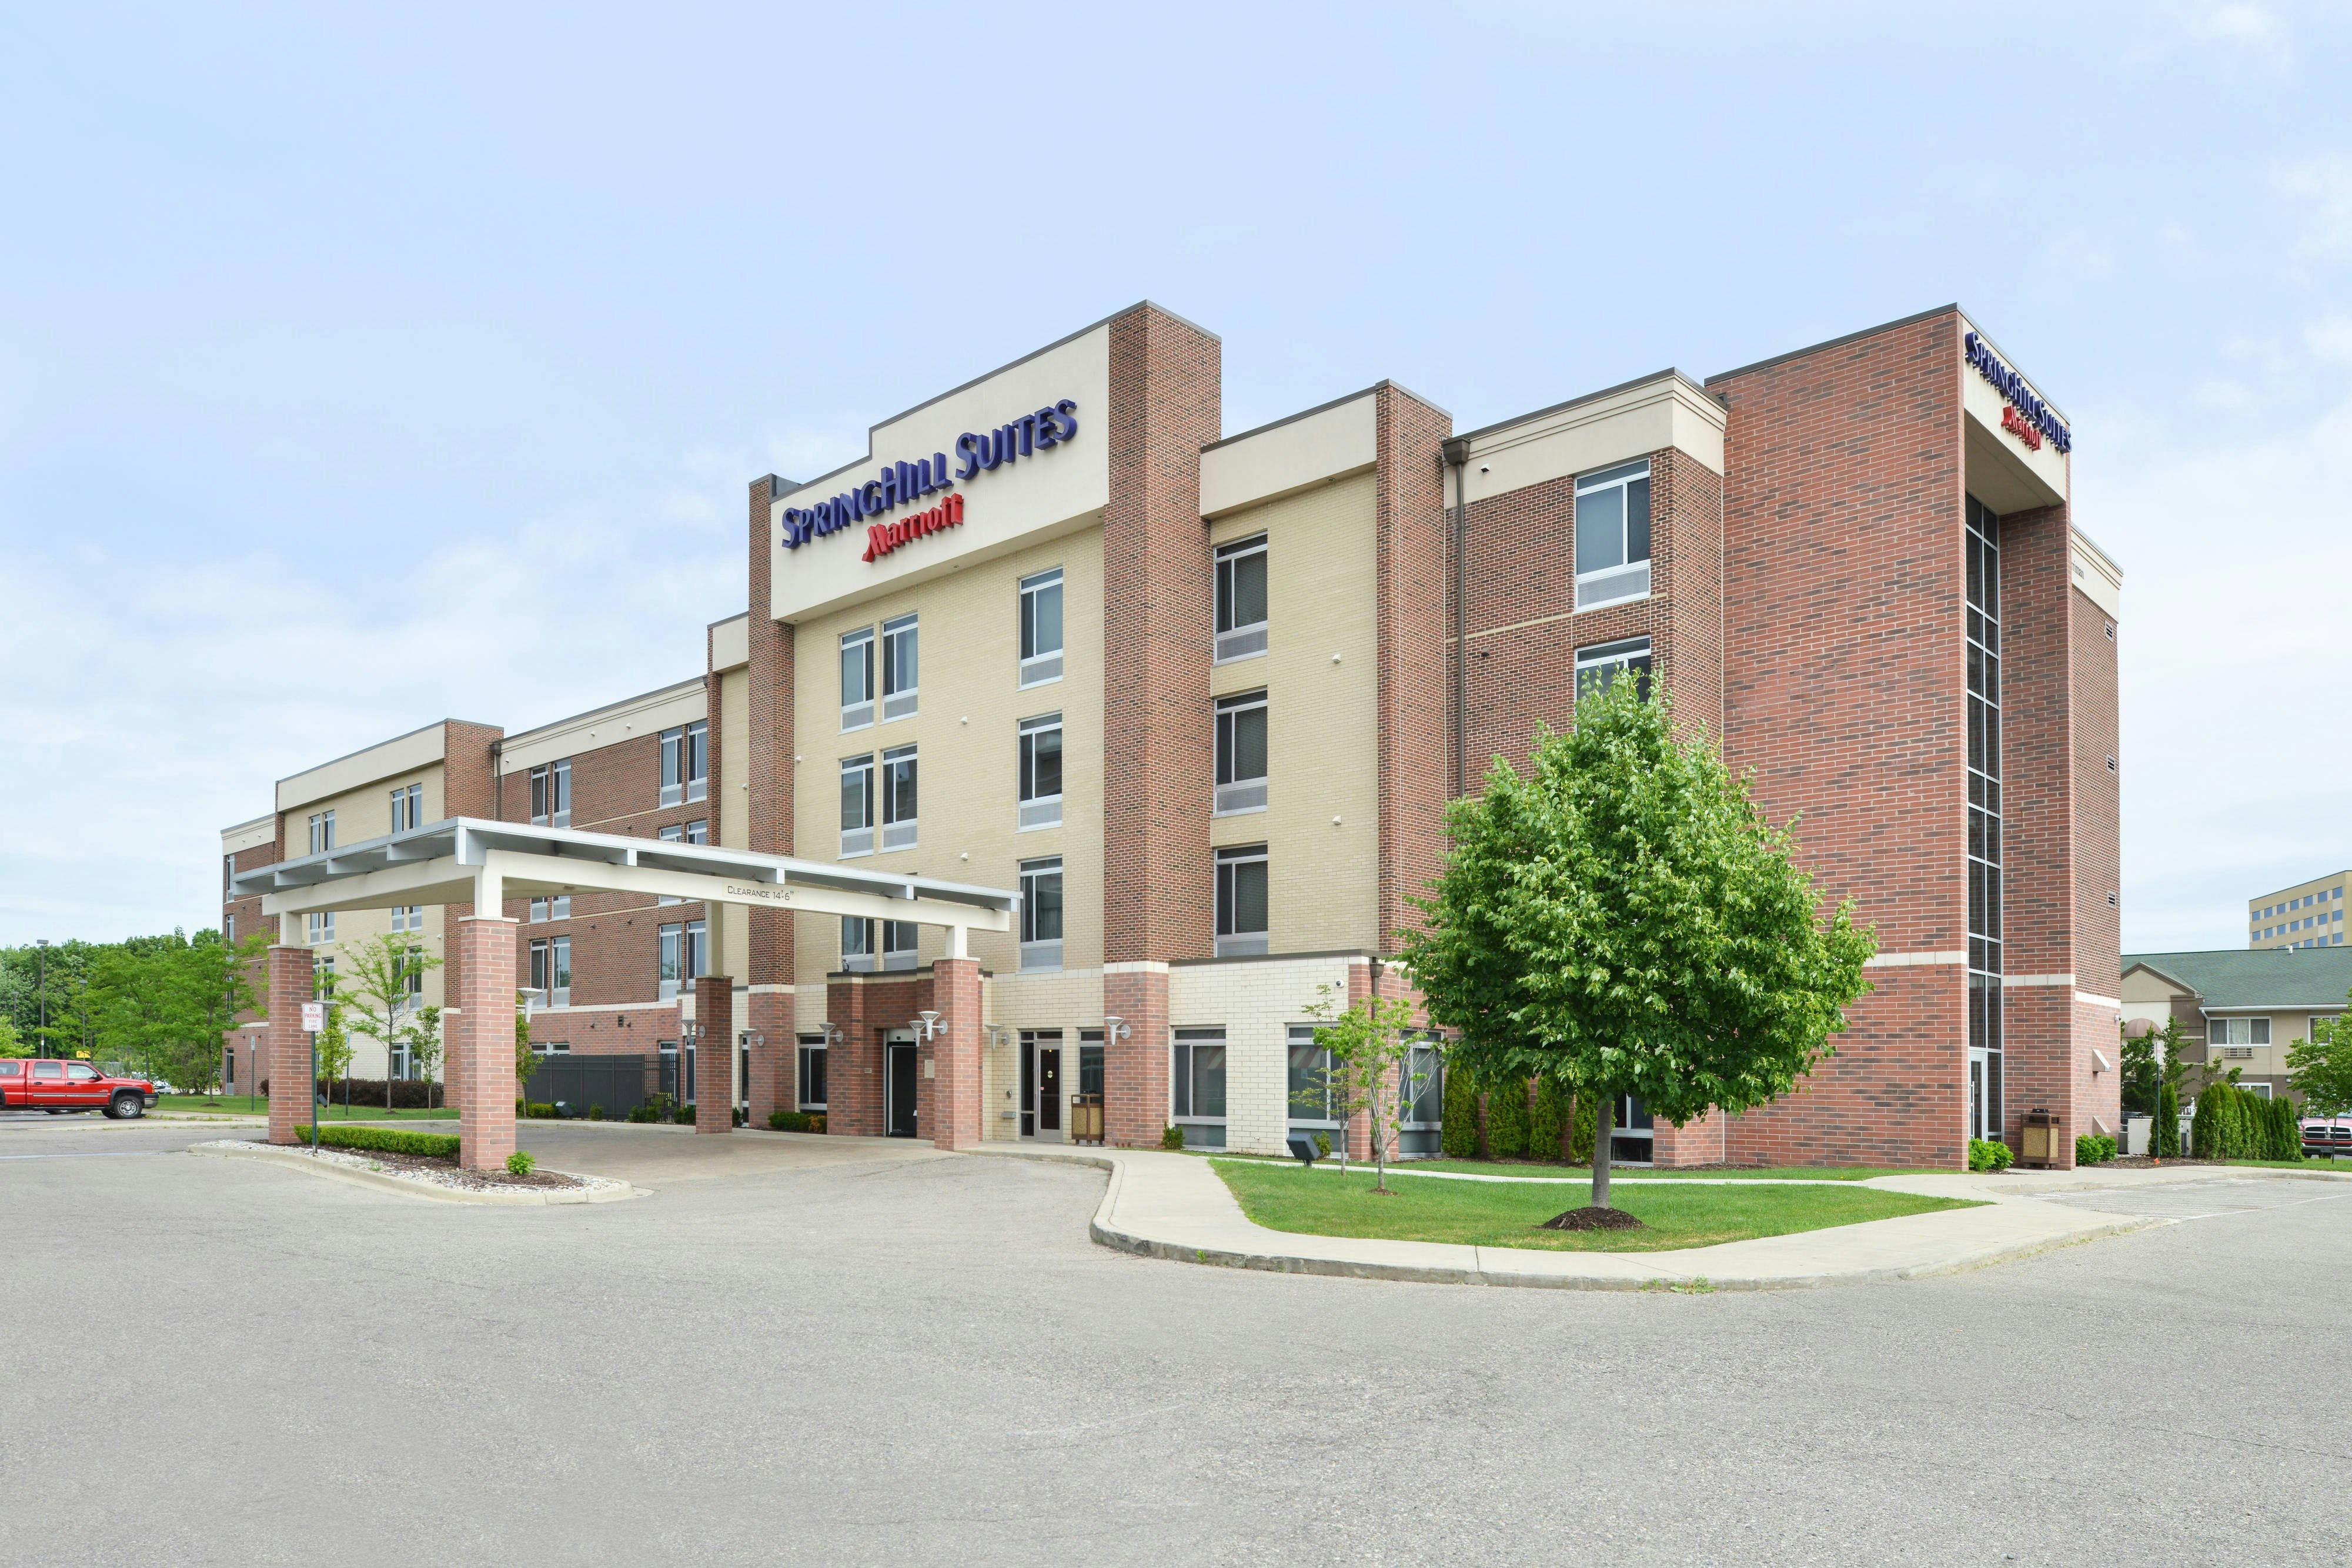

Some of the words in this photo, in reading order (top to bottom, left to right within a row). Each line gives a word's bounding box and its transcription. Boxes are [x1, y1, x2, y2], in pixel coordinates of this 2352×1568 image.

[1965, 332, 2037, 422] SPRINGHILL
[2032, 400, 2072, 454] SUITES
[782, 452, 954, 549] SPRINGHILL
[956, 399, 1077, 480] SUITES
[862, 493, 964, 563] Marriott
[727, 885, 770, 898] CLEARANCE
